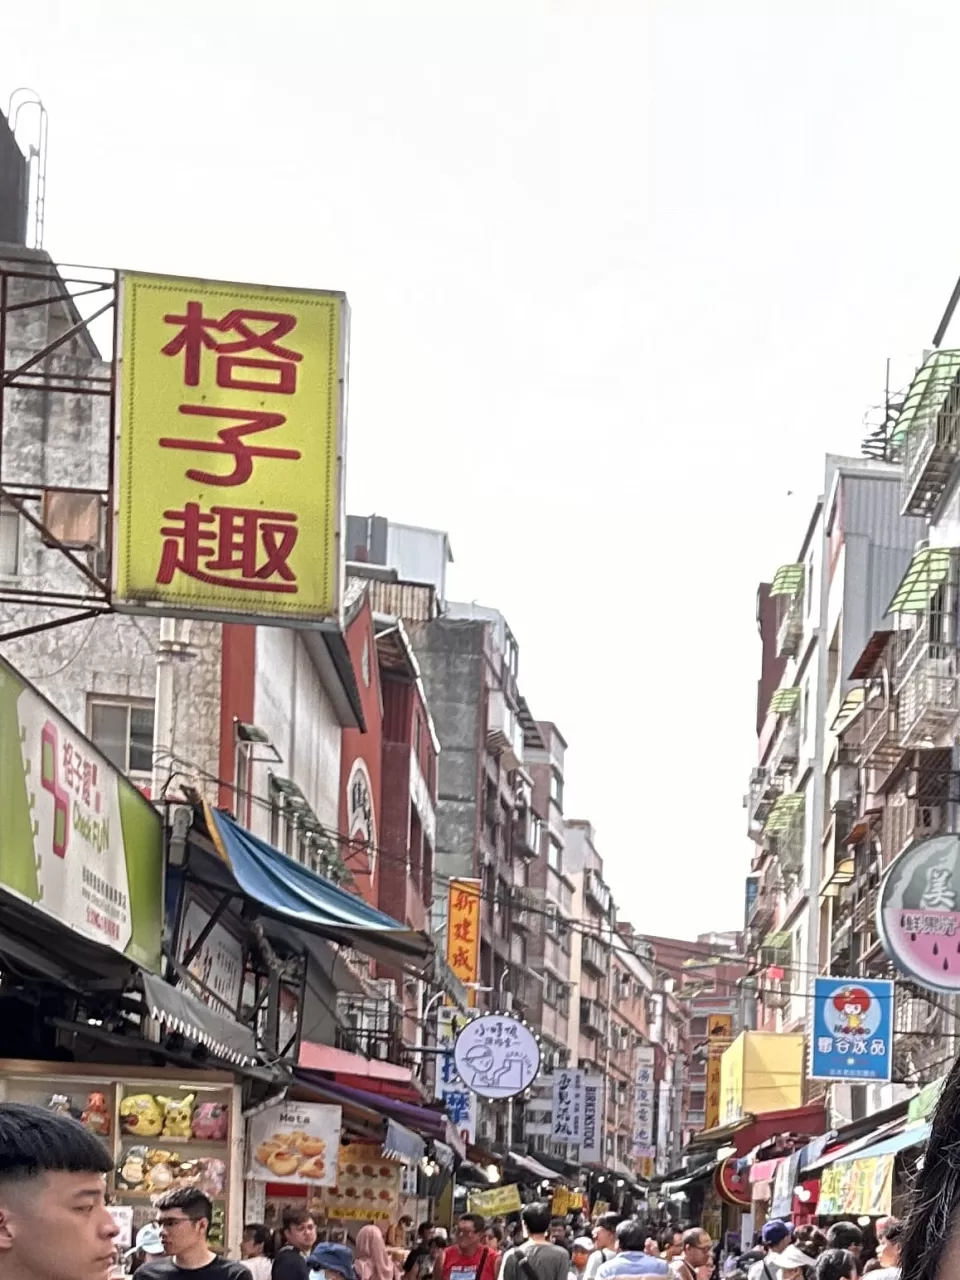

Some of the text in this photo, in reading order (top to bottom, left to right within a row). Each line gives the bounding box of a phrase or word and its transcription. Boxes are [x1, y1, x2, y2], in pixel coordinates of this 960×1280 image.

[156, 301, 304, 593] 格子趣
[452, 890, 477, 981] 新建成
[583, 1086, 597, 1149] BIRKENSTOCK
